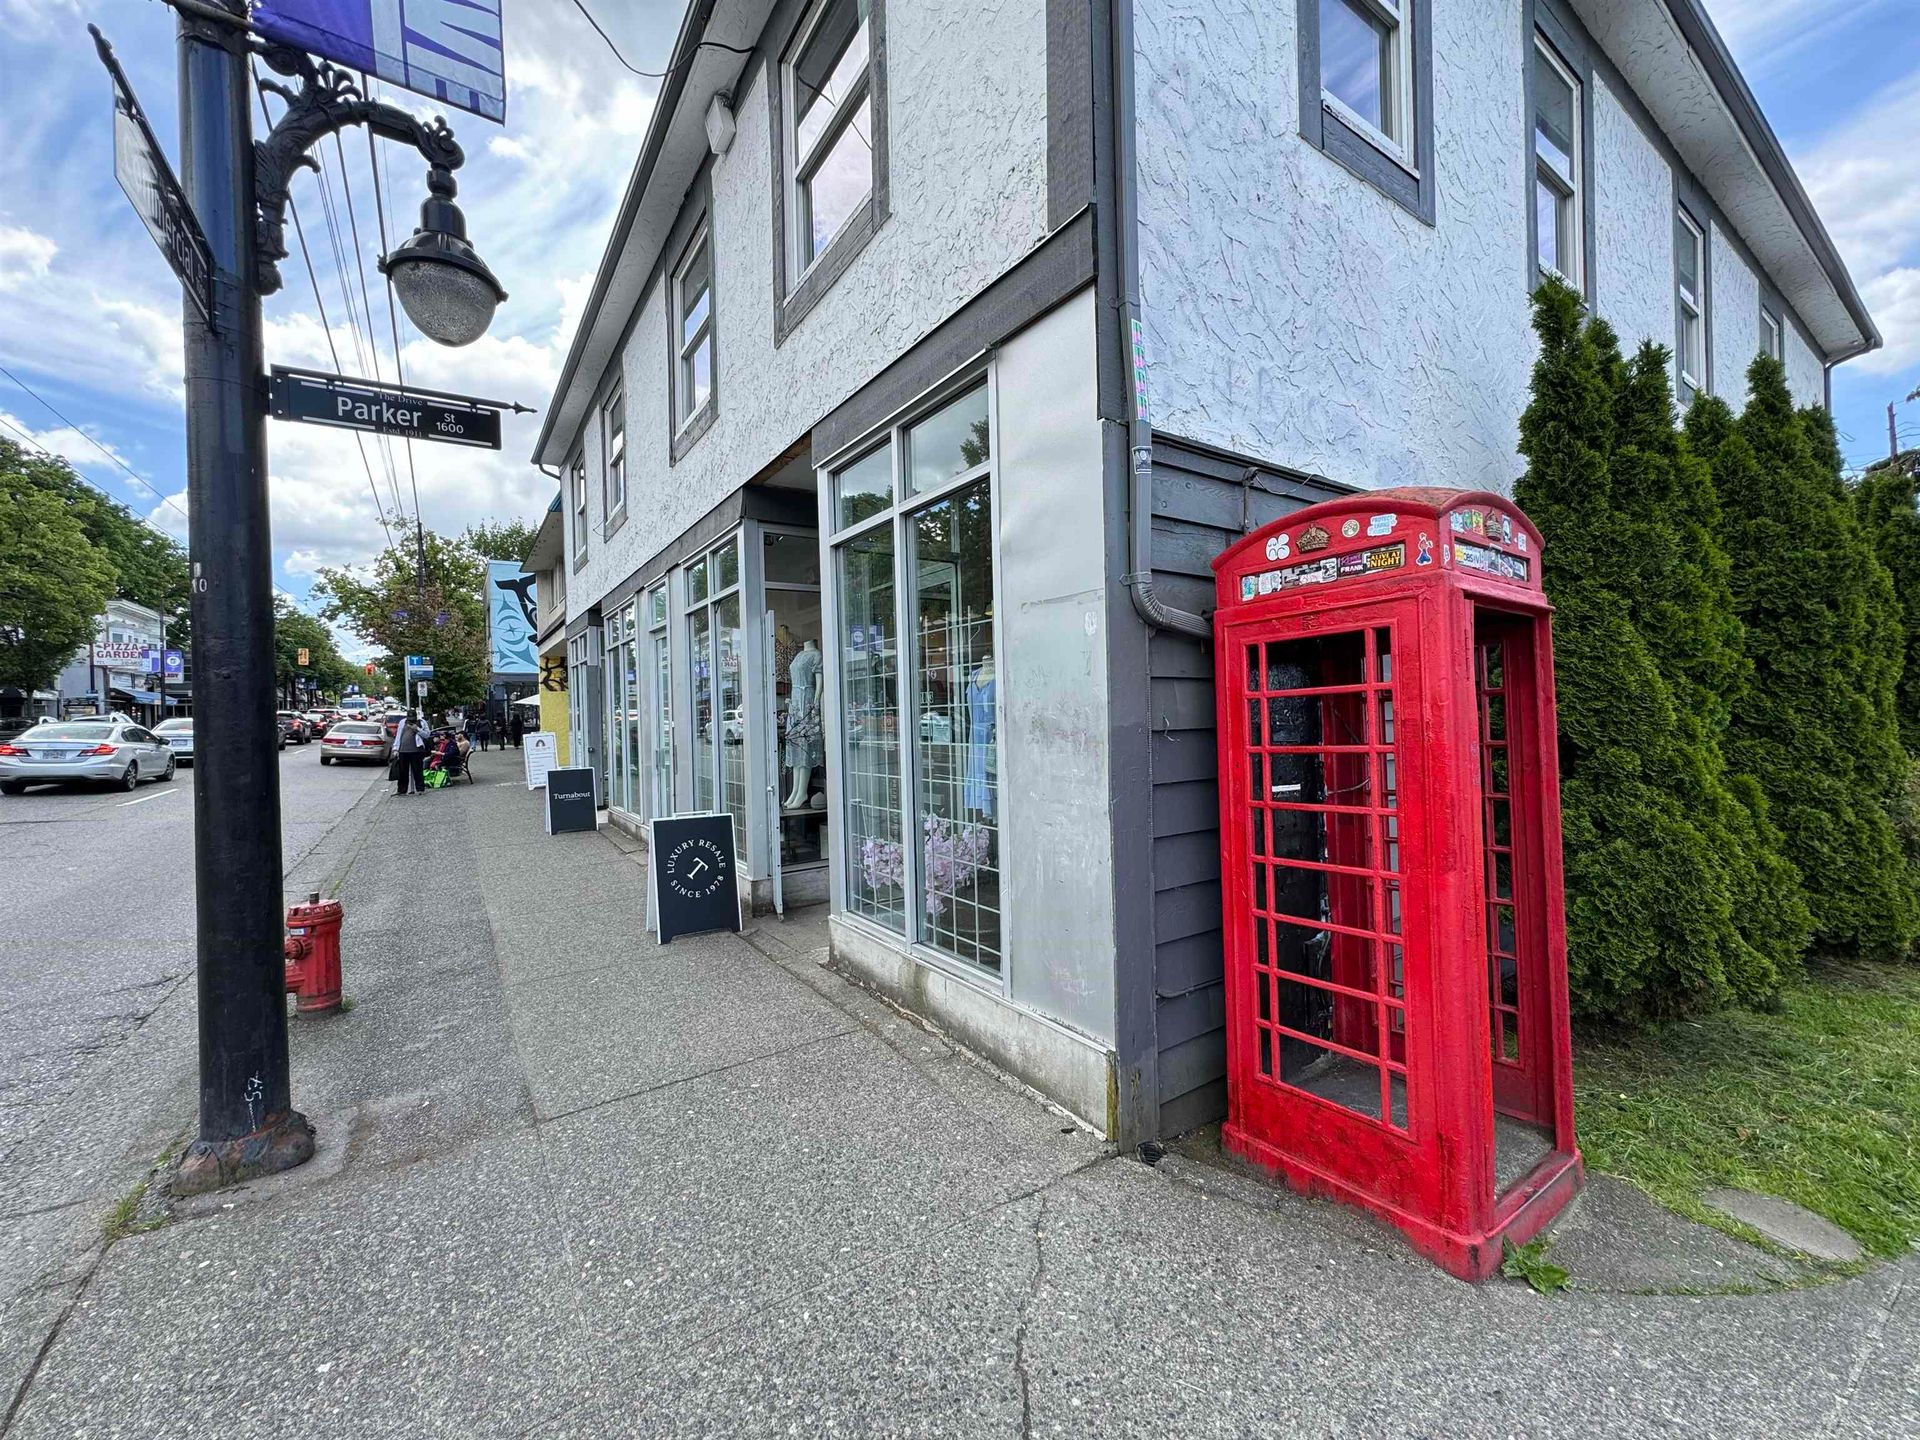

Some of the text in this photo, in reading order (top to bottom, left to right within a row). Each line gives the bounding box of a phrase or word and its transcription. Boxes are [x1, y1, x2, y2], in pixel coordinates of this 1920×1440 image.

[379, 392, 423, 406] The Drive
[337, 396, 422, 427] Parker
[444, 413, 456, 424] St
[405, 429, 423, 438] 1911
[436, 422, 464, 434] 1600
[1370, 552, 1389, 560] ALIVE
[1370, 557, 1400, 567] NIGHT
[1340, 564, 1364, 573] FRANK
[103, 643, 138, 651] PIZZA
[553, 791, 592, 800] Turnabout
[667, 838, 726, 874] LUXURY RESALE
[687, 857, 709, 880] T
[670, 875, 724, 898] SINCE 1978
